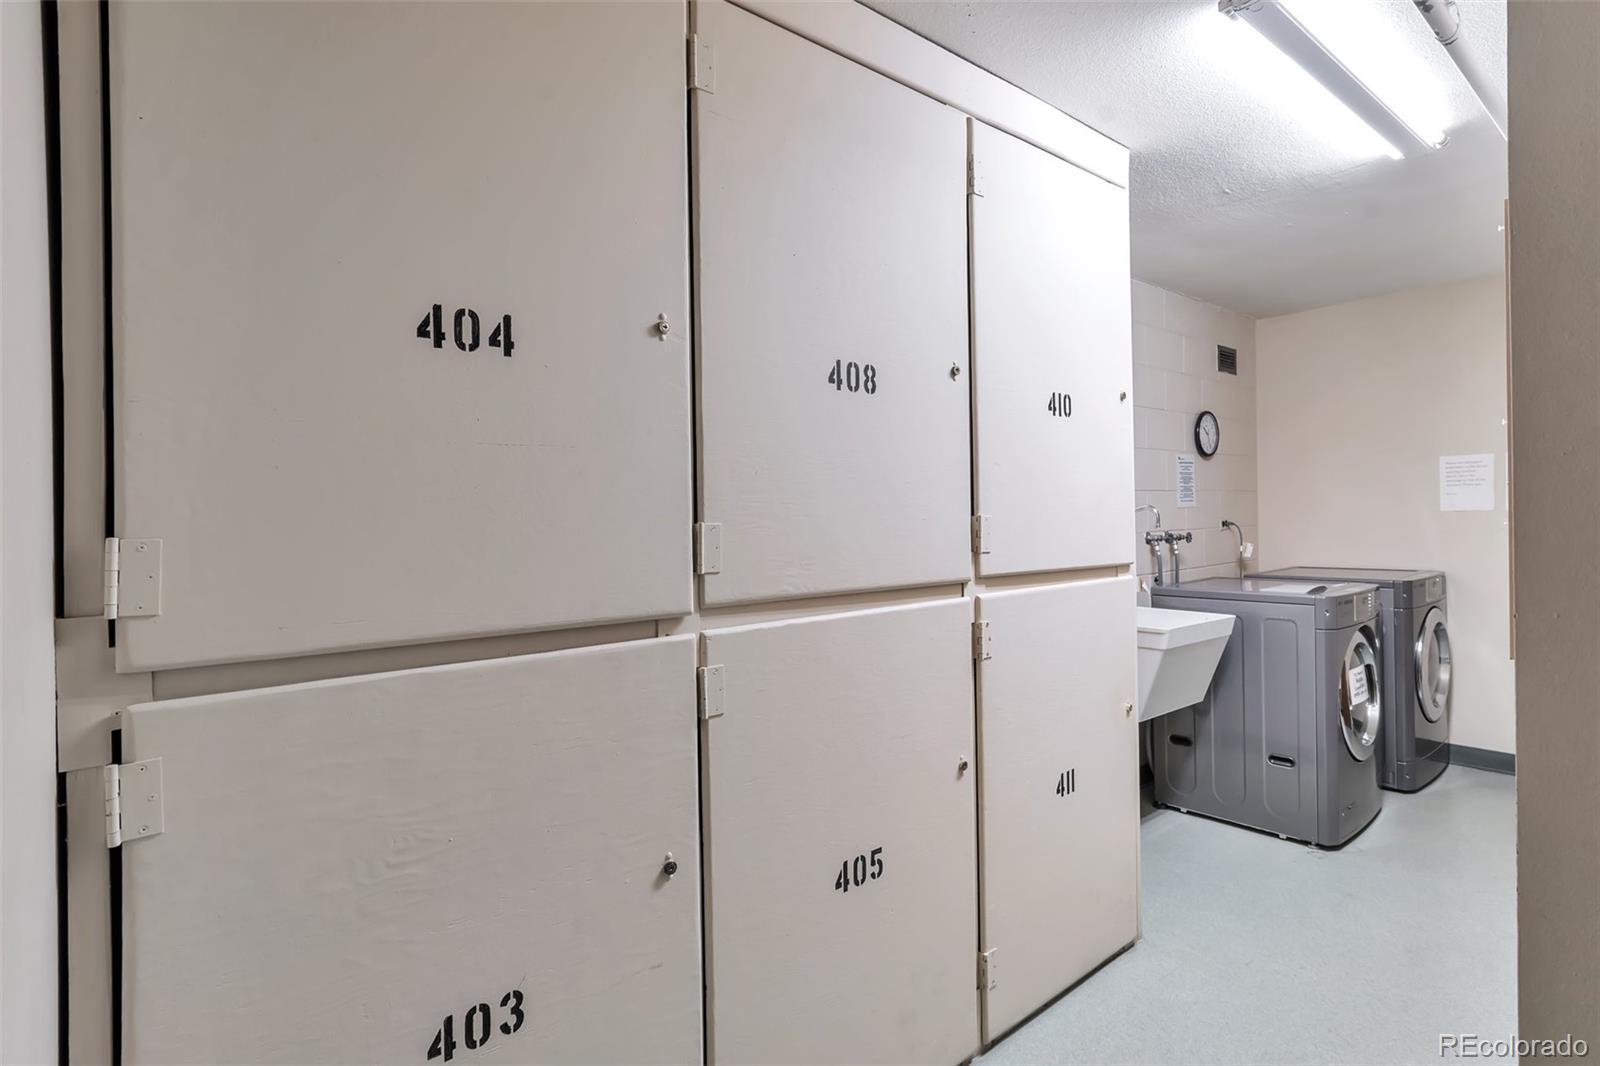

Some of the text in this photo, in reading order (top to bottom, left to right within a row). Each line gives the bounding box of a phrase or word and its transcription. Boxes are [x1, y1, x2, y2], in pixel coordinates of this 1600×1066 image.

[417, 304, 514, 357] 404
[828, 360, 876, 395] 408
[1048, 392, 1071, 417] 410
[1056, 768, 1075, 797] 411
[835, 847, 883, 893] 405
[427, 990, 524, 1062] 403
